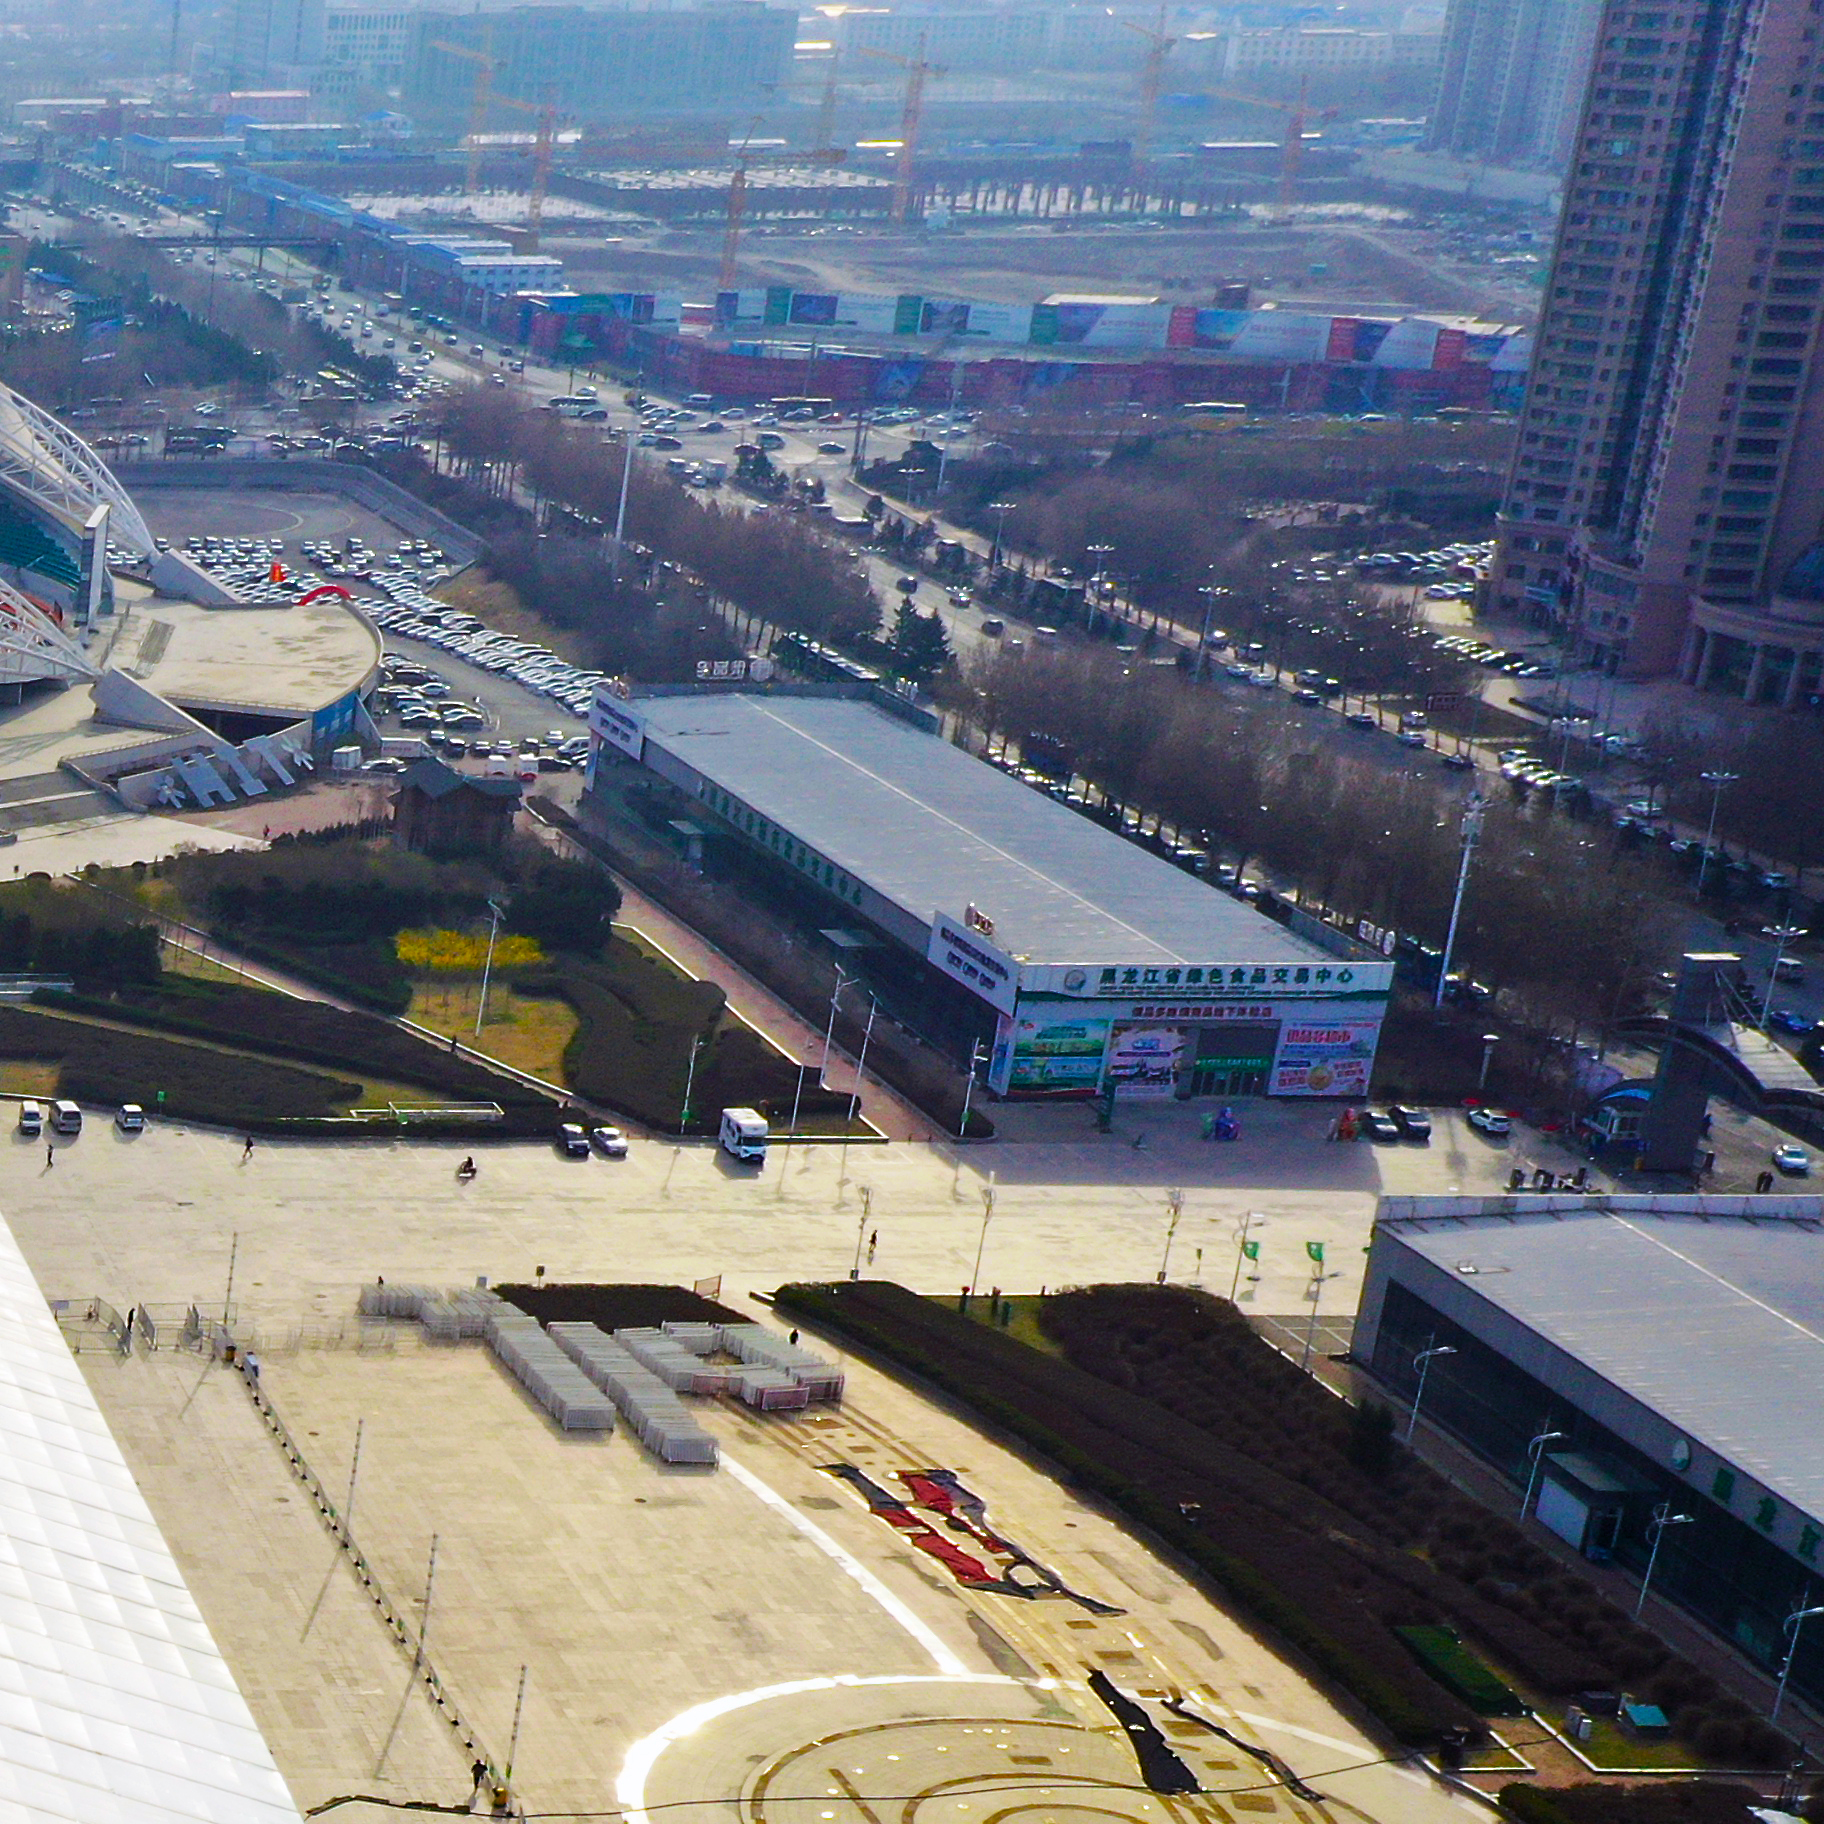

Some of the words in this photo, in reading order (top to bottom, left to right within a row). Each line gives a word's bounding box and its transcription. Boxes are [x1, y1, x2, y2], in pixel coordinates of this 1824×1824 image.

[1099, 967, 1354, 984] 黑龙江省绿色食品交易中心
